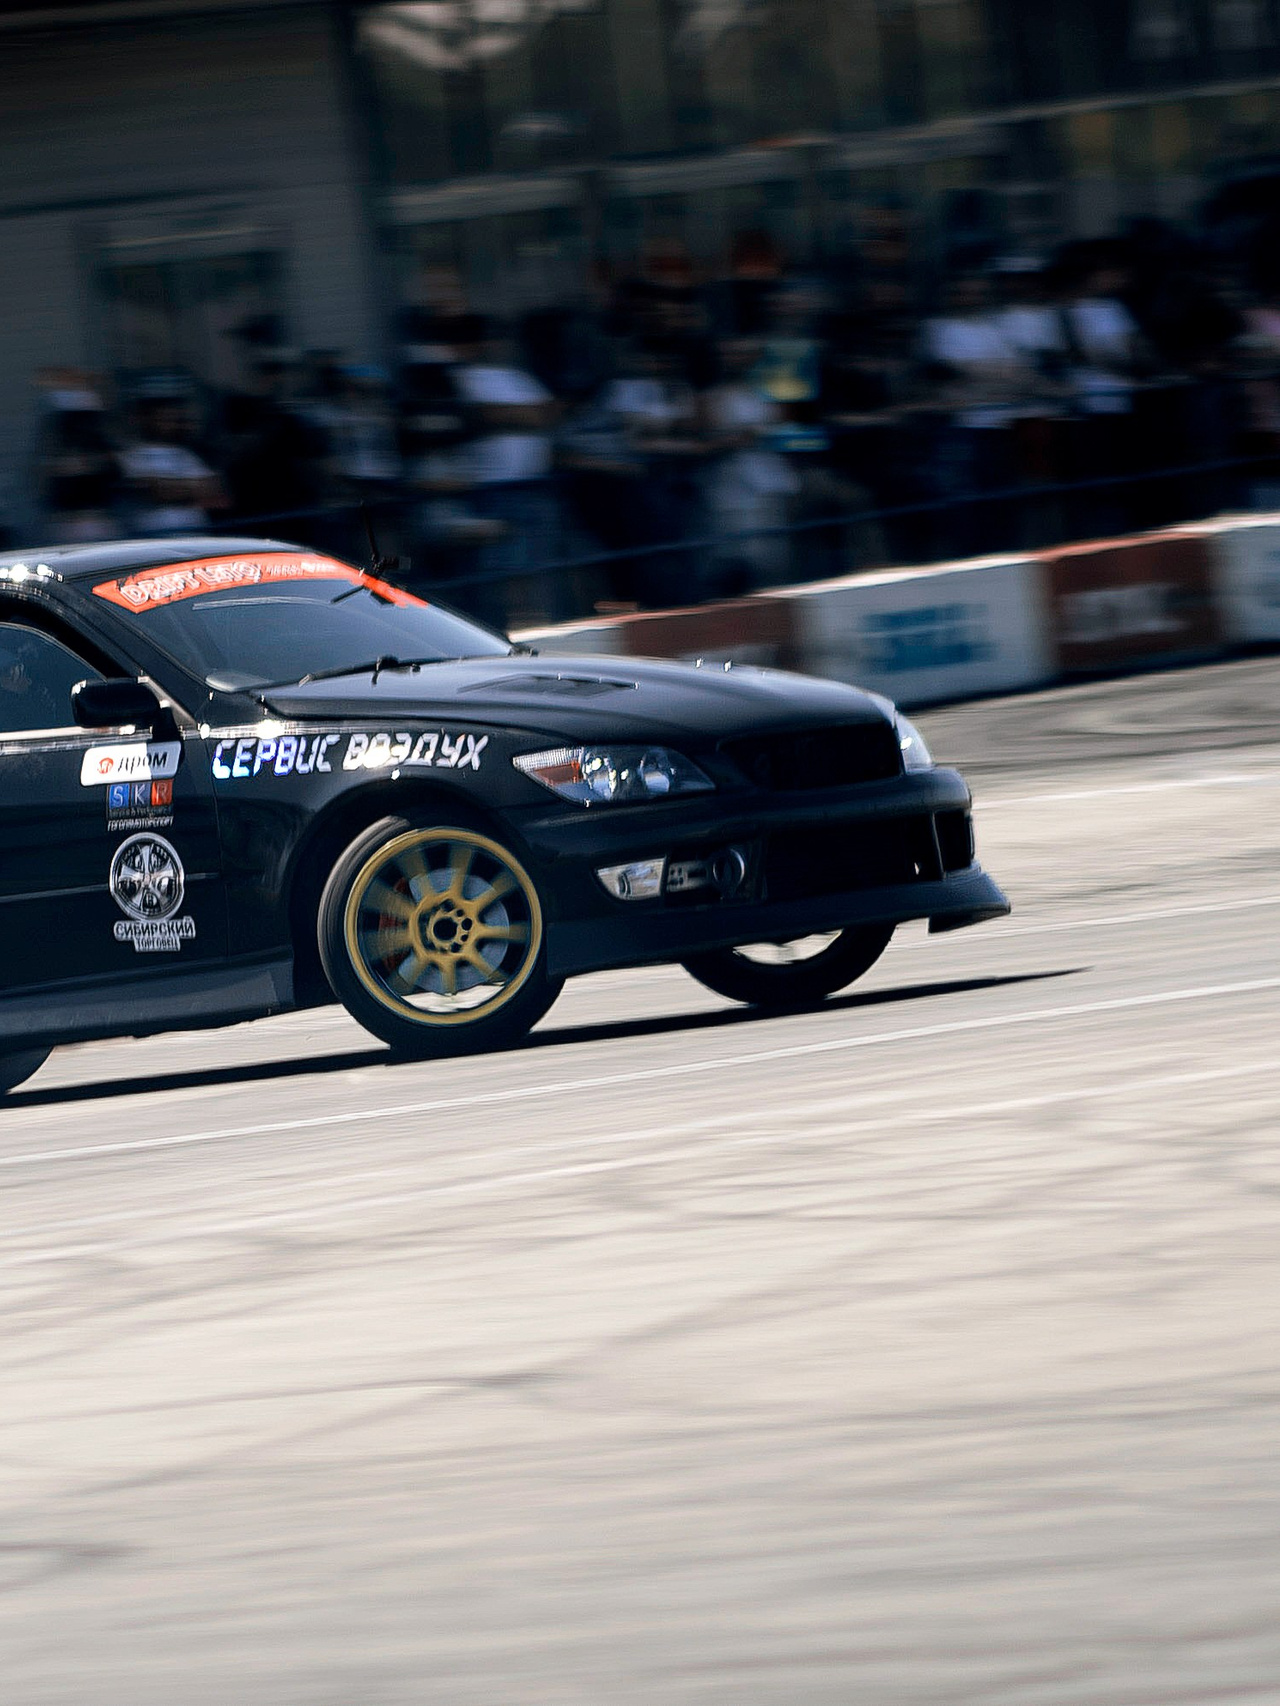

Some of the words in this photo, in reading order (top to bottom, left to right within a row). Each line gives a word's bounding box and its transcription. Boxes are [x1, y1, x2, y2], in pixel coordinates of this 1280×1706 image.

[212, 735, 340, 779] СЕРВИС
[342, 733, 488, 770] ВОЗДУХ
[112, 782, 170, 807] SKR
[116, 917, 194, 938] СИБИРСКИЙ
